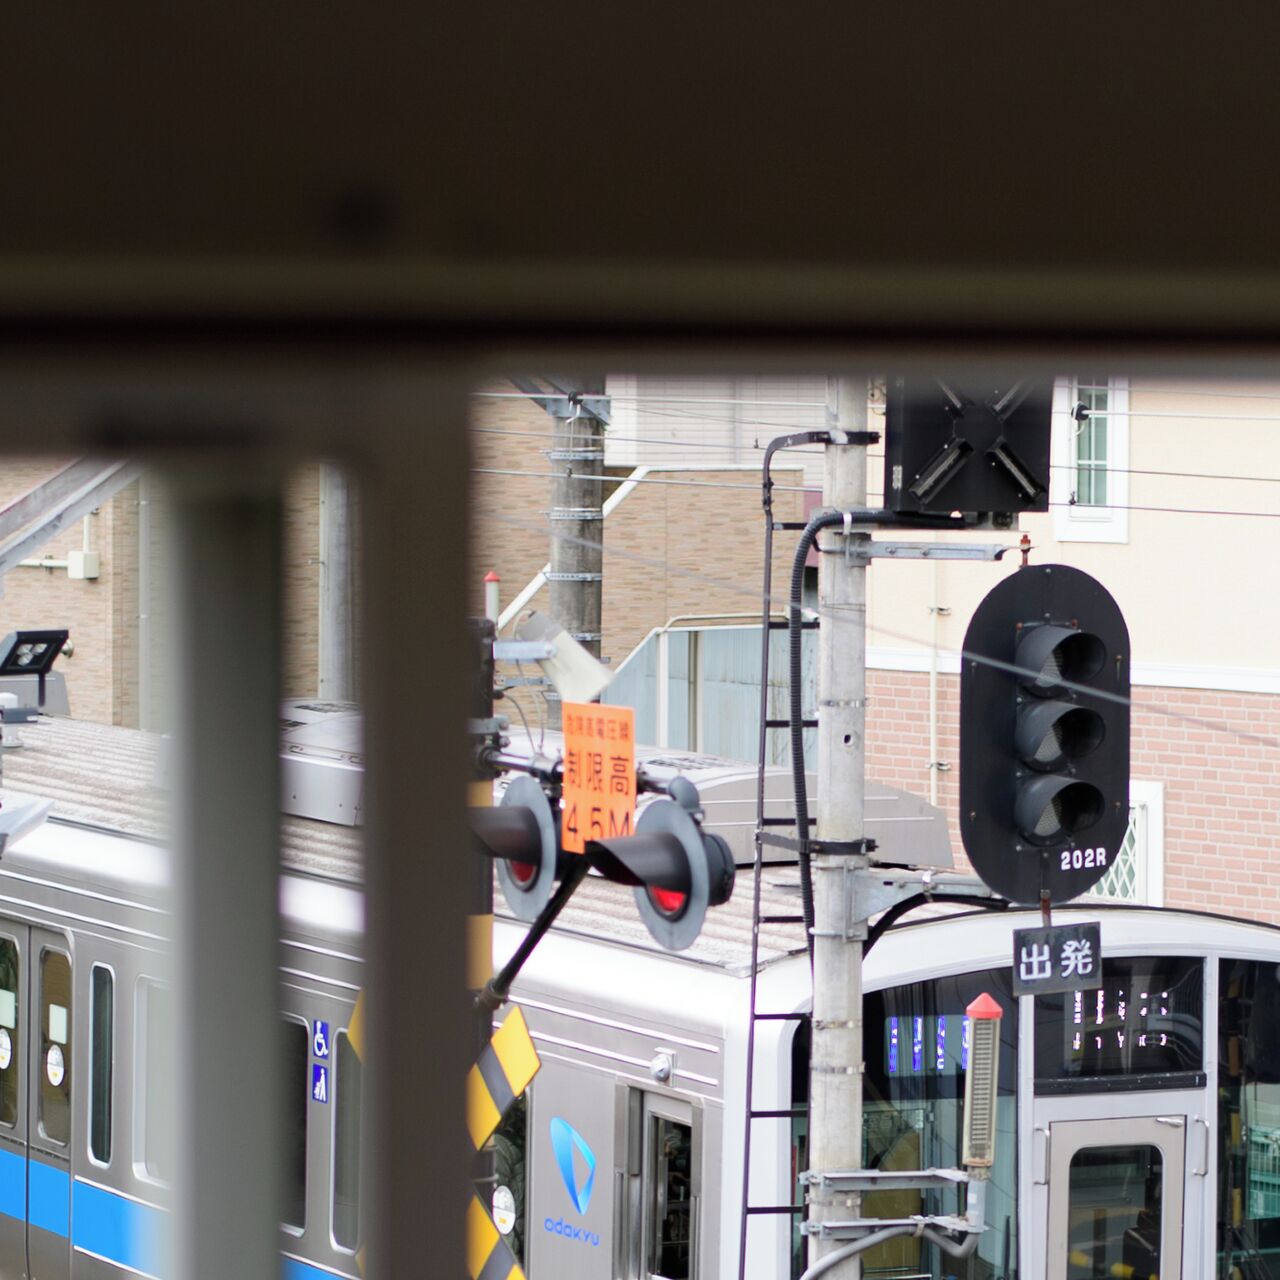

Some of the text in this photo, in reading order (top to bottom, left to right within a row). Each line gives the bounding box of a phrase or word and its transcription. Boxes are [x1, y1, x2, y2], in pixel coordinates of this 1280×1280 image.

[568, 749, 630, 796] 制限高
[1060, 847, 1107, 871] 202R
[1019, 939, 1093, 981] 出発
